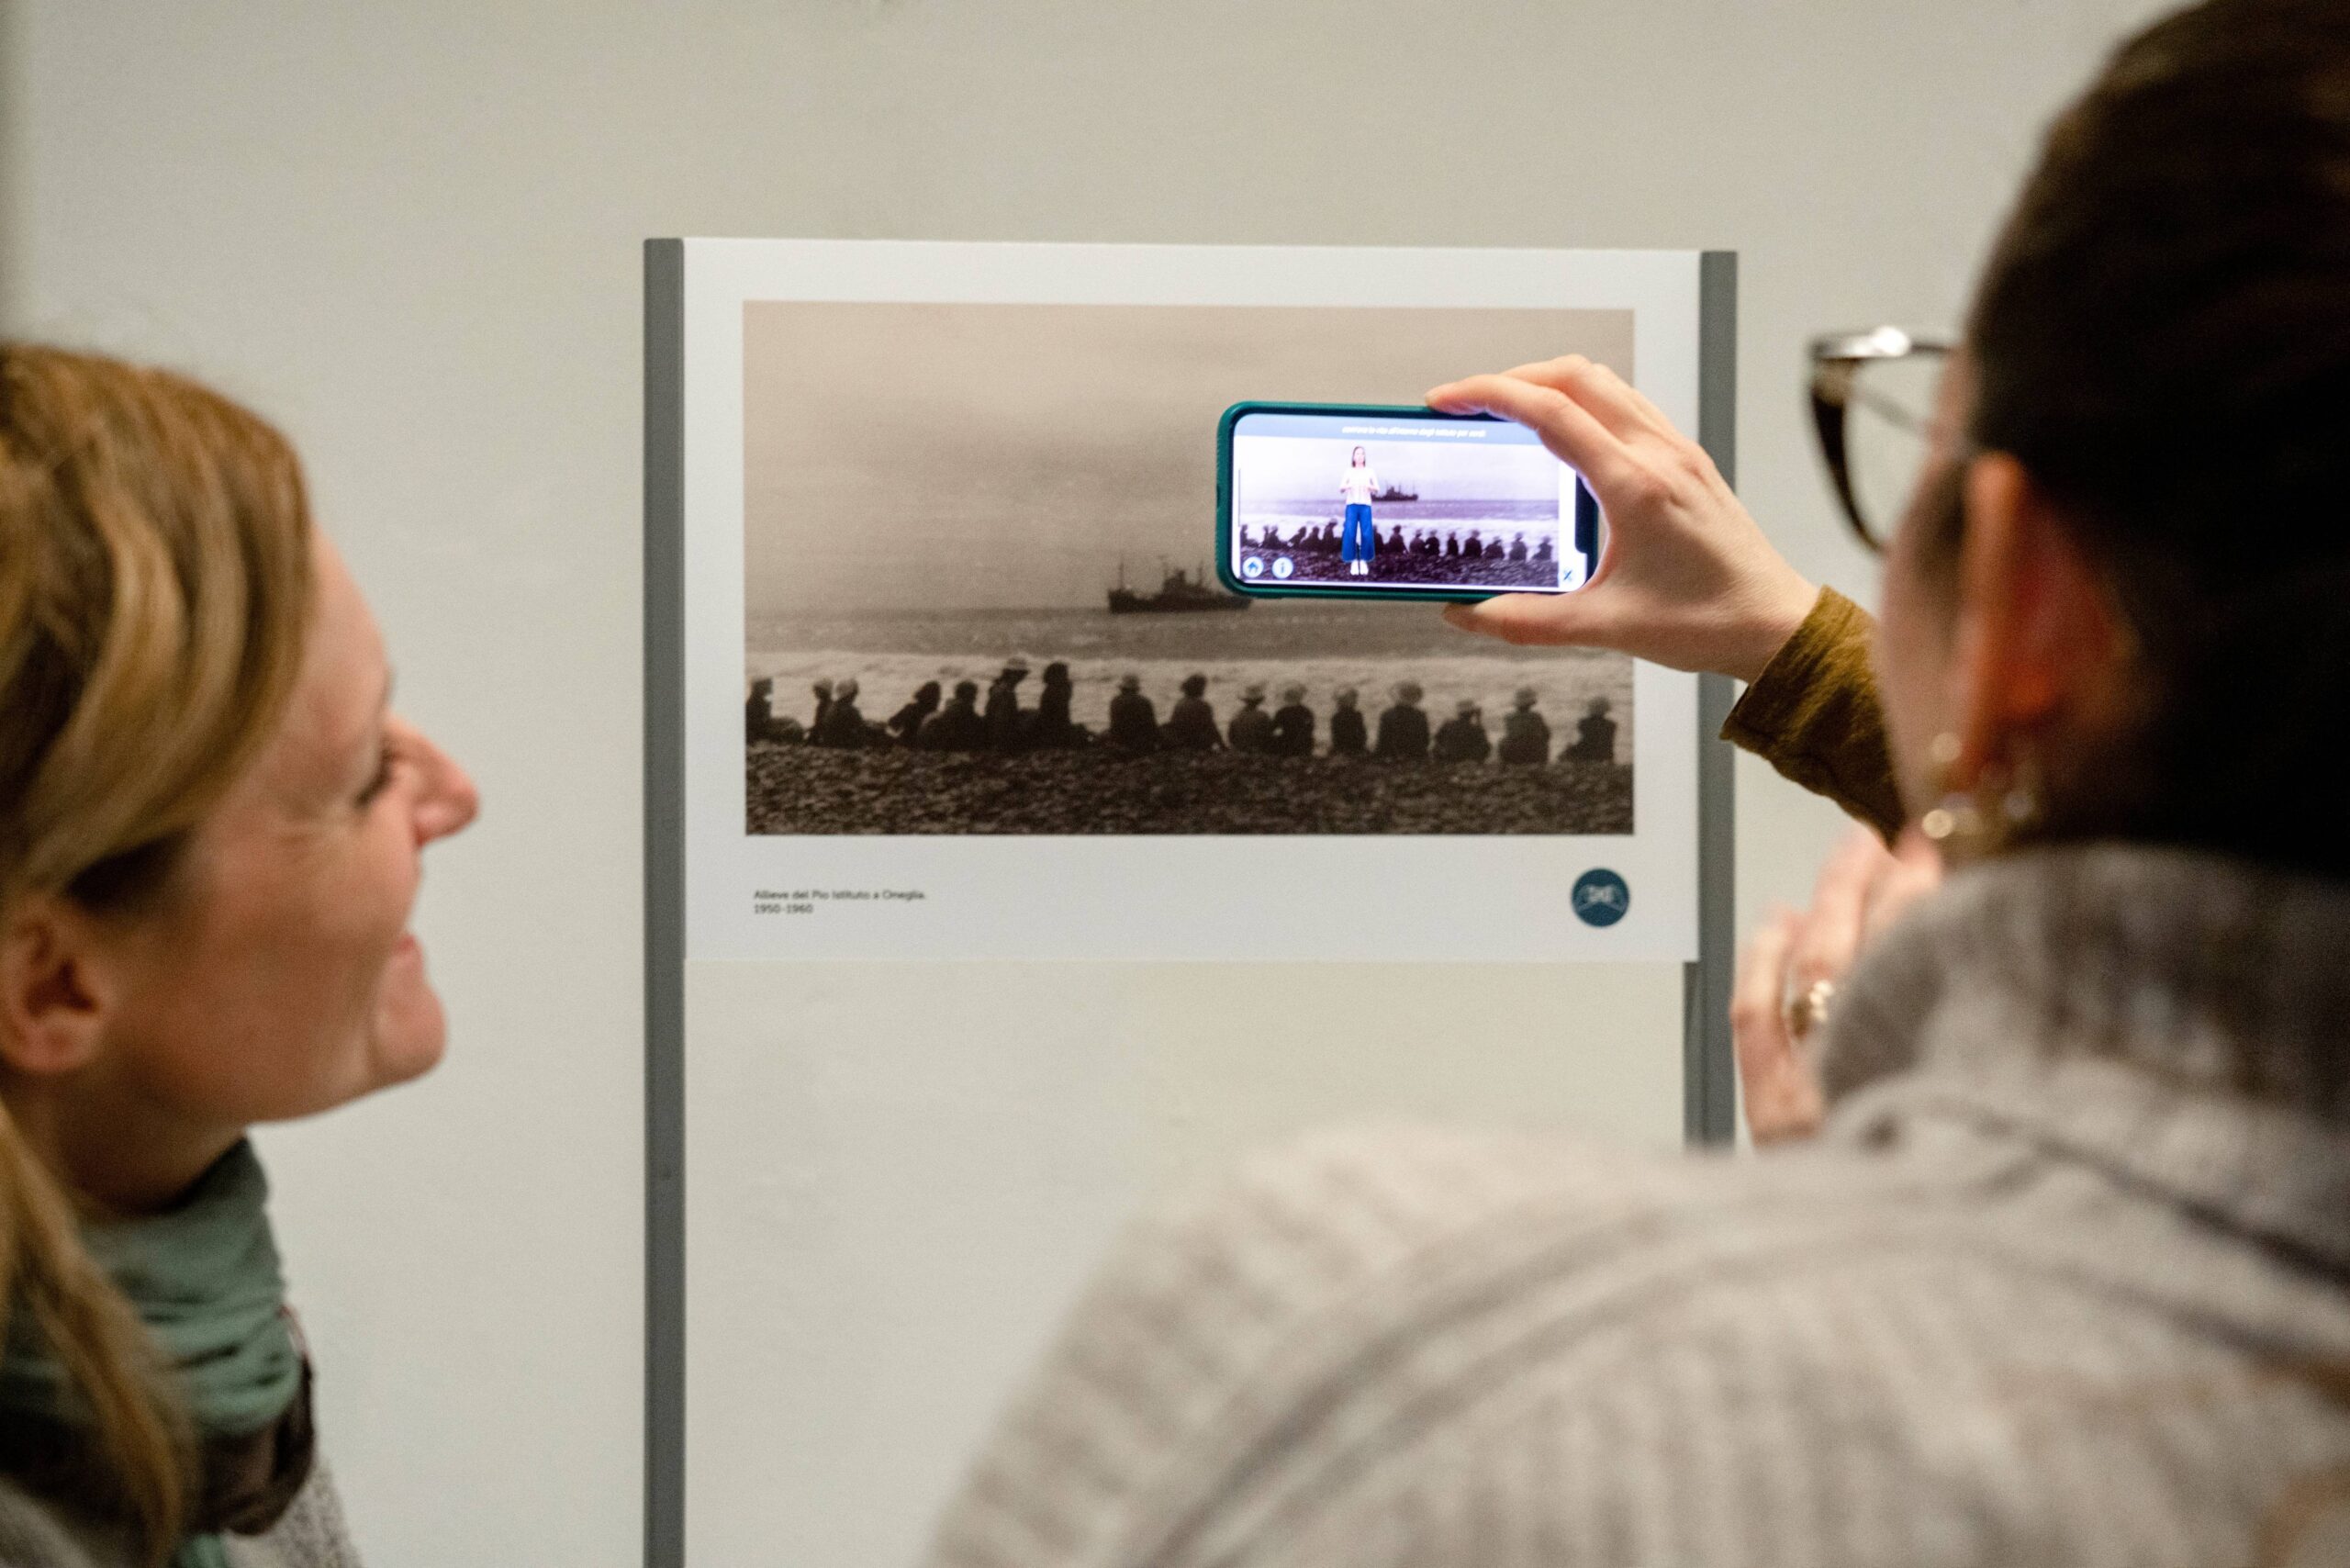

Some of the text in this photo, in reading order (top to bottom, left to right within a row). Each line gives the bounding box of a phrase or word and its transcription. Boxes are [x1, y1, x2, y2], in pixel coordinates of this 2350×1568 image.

[754, 890, 789, 899] Allieve
[792, 890, 809, 899] del
[811, 890, 830, 900] Pio
[832, 890, 871, 900] Istituto
[873, 891, 879, 900] a
[755, 903, 814, 914] 1950-1960
